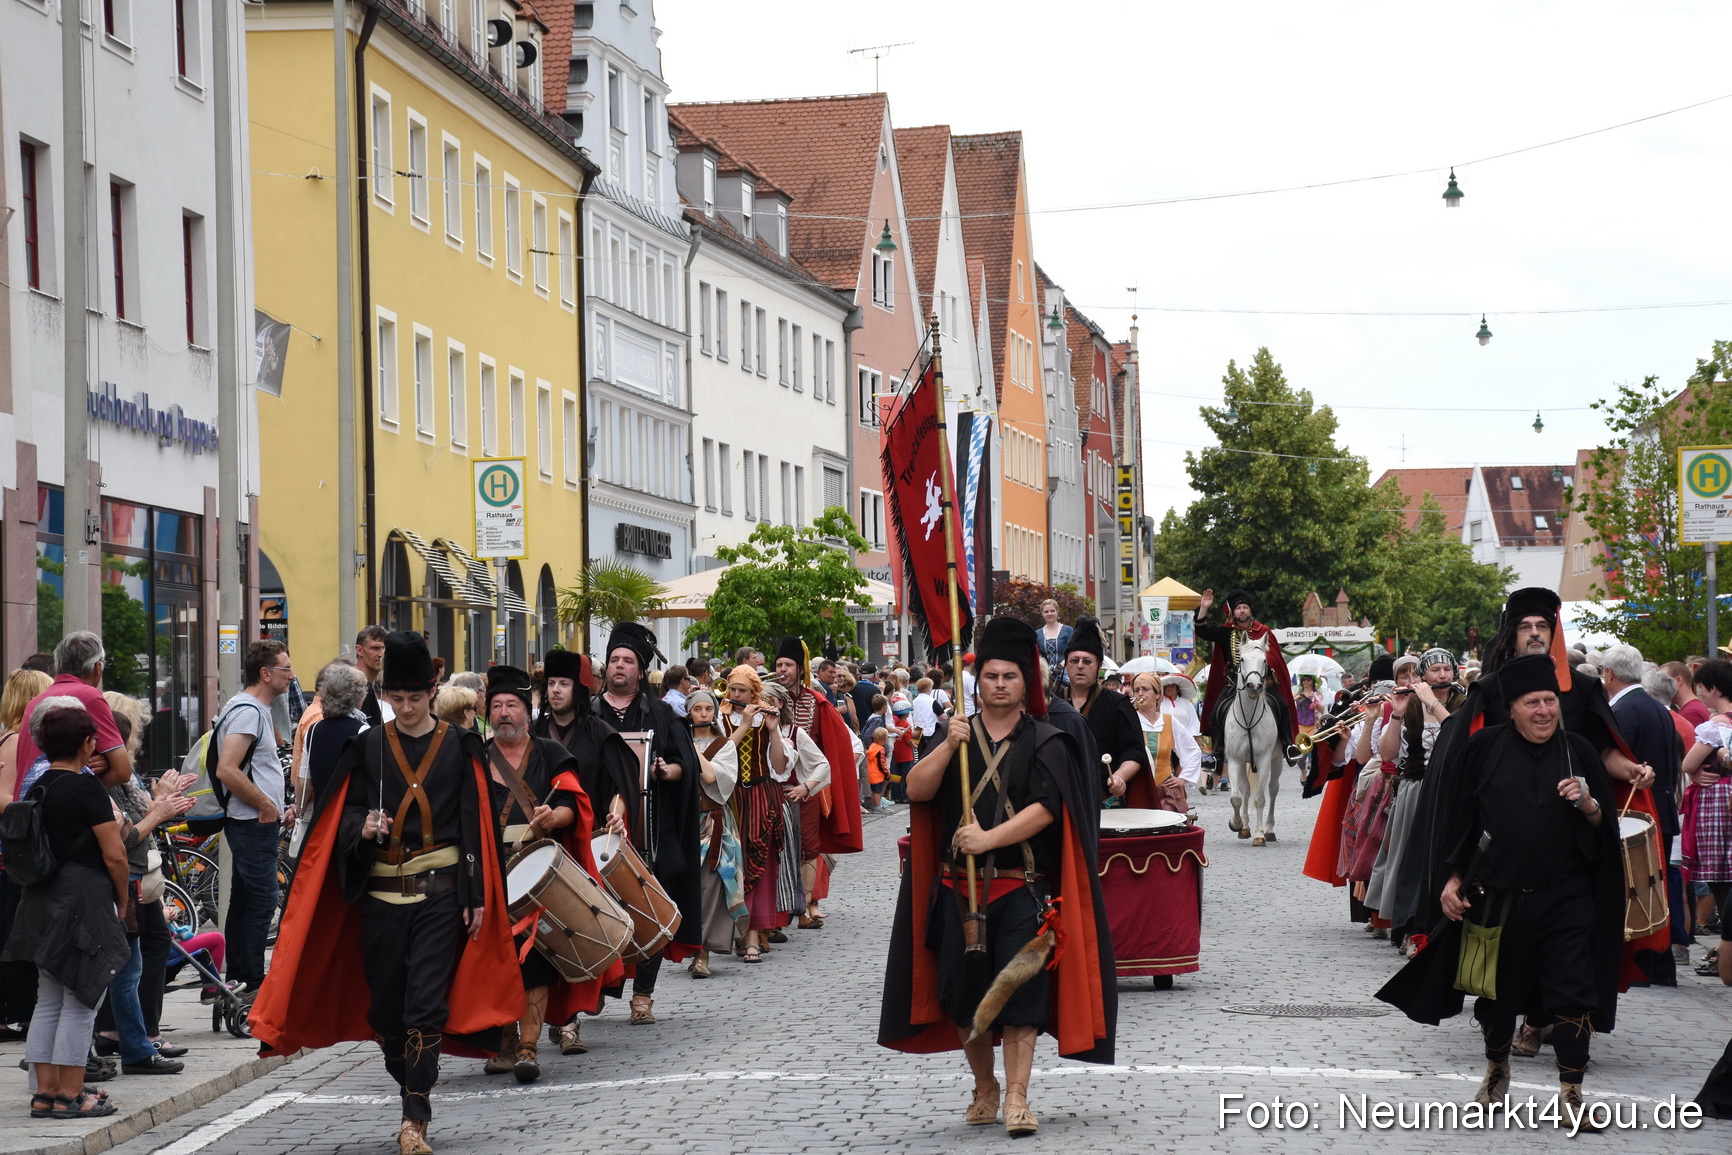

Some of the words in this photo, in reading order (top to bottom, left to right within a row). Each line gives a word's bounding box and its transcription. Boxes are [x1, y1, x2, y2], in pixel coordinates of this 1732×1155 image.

[87, 381, 173, 447] uchhandlung
[177, 404, 218, 455] Ruppre
[623, 523, 649, 556] BRILLEN
[648, 529, 672, 560] WEBER
[1118, 468, 1134, 583] HOTEL
[1286, 630, 1318, 638] PARKSTEIN
[1324, 630, 1343, 638] KRONE
